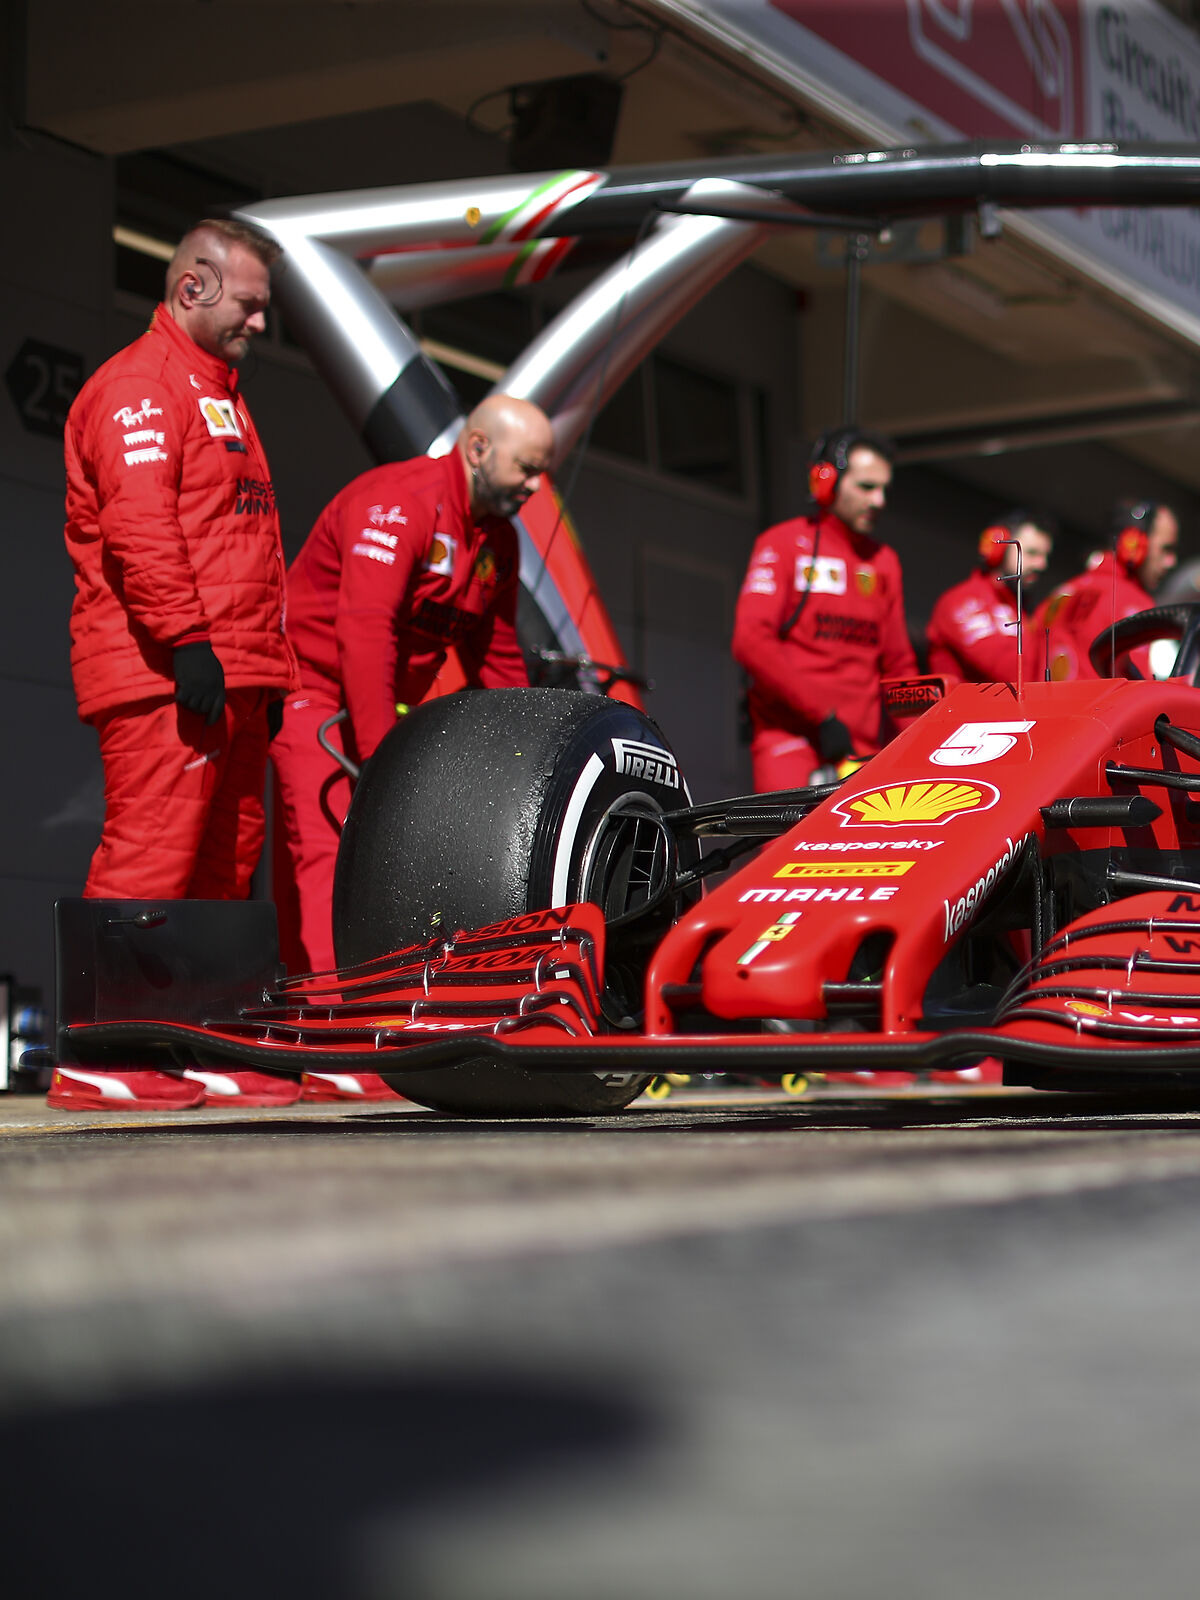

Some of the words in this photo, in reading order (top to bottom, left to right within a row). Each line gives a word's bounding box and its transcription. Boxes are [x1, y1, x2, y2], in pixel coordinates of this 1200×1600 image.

[928, 720, 1037, 767] 5
[610, 738, 679, 790] PIRELLI
[793, 839, 945, 852] kaspersky
[738, 887, 900, 902] MAHLE
[460, 906, 574, 940] SSION
